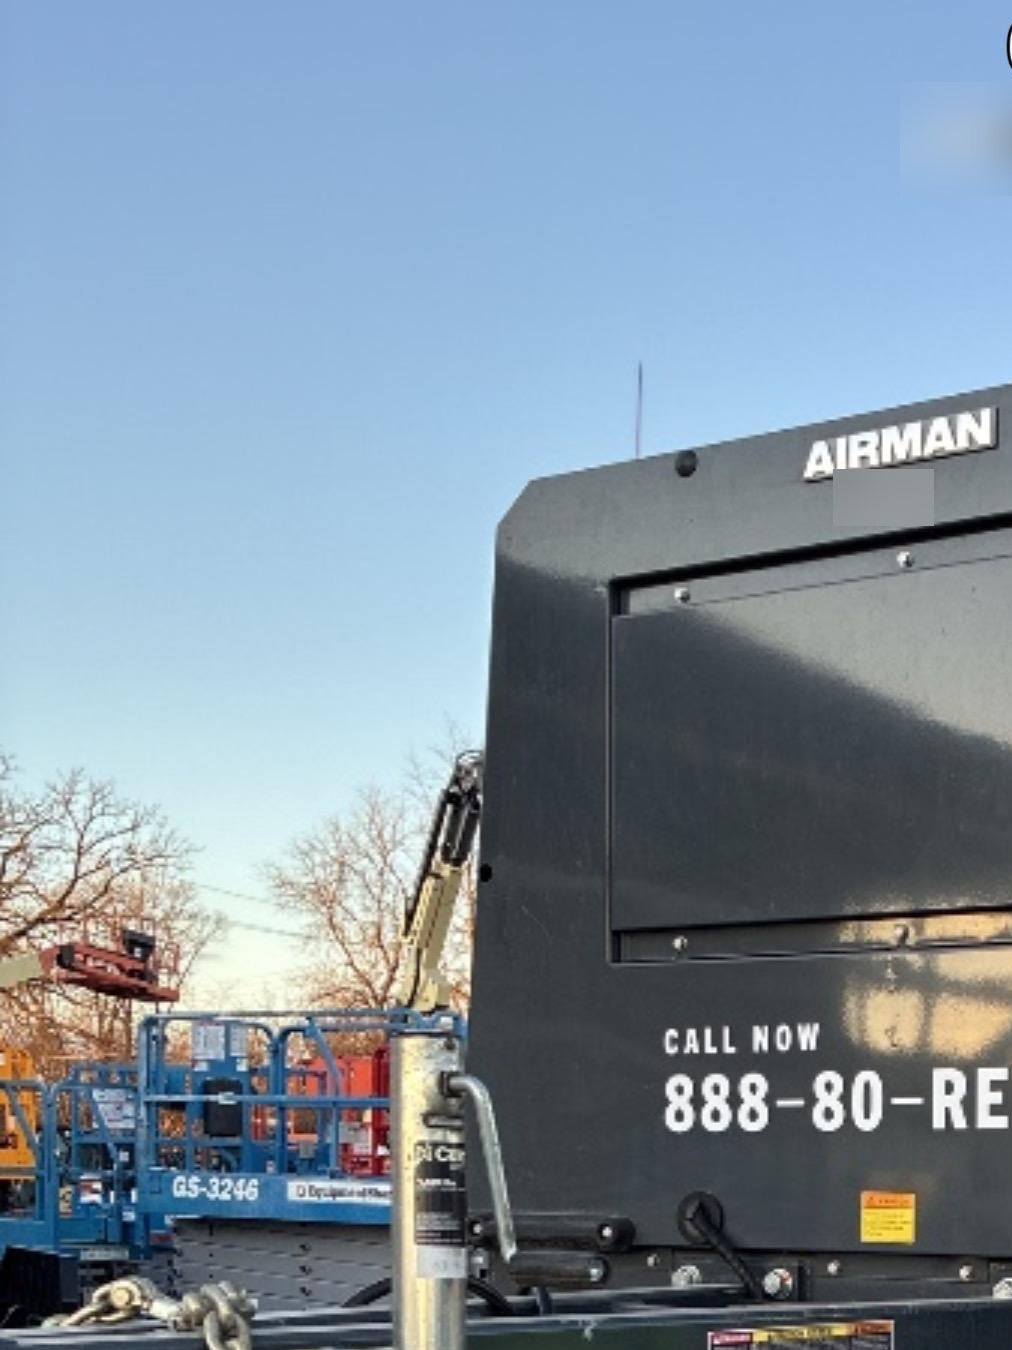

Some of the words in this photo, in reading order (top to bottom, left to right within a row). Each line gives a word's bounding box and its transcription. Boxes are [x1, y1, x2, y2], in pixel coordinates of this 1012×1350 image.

[803, 407, 993, 479] AIRMAN
[664, 1027, 737, 1056] CALL
[752, 1021, 820, 1054] NOW
[172, 1175, 259, 1201] GS-3246
